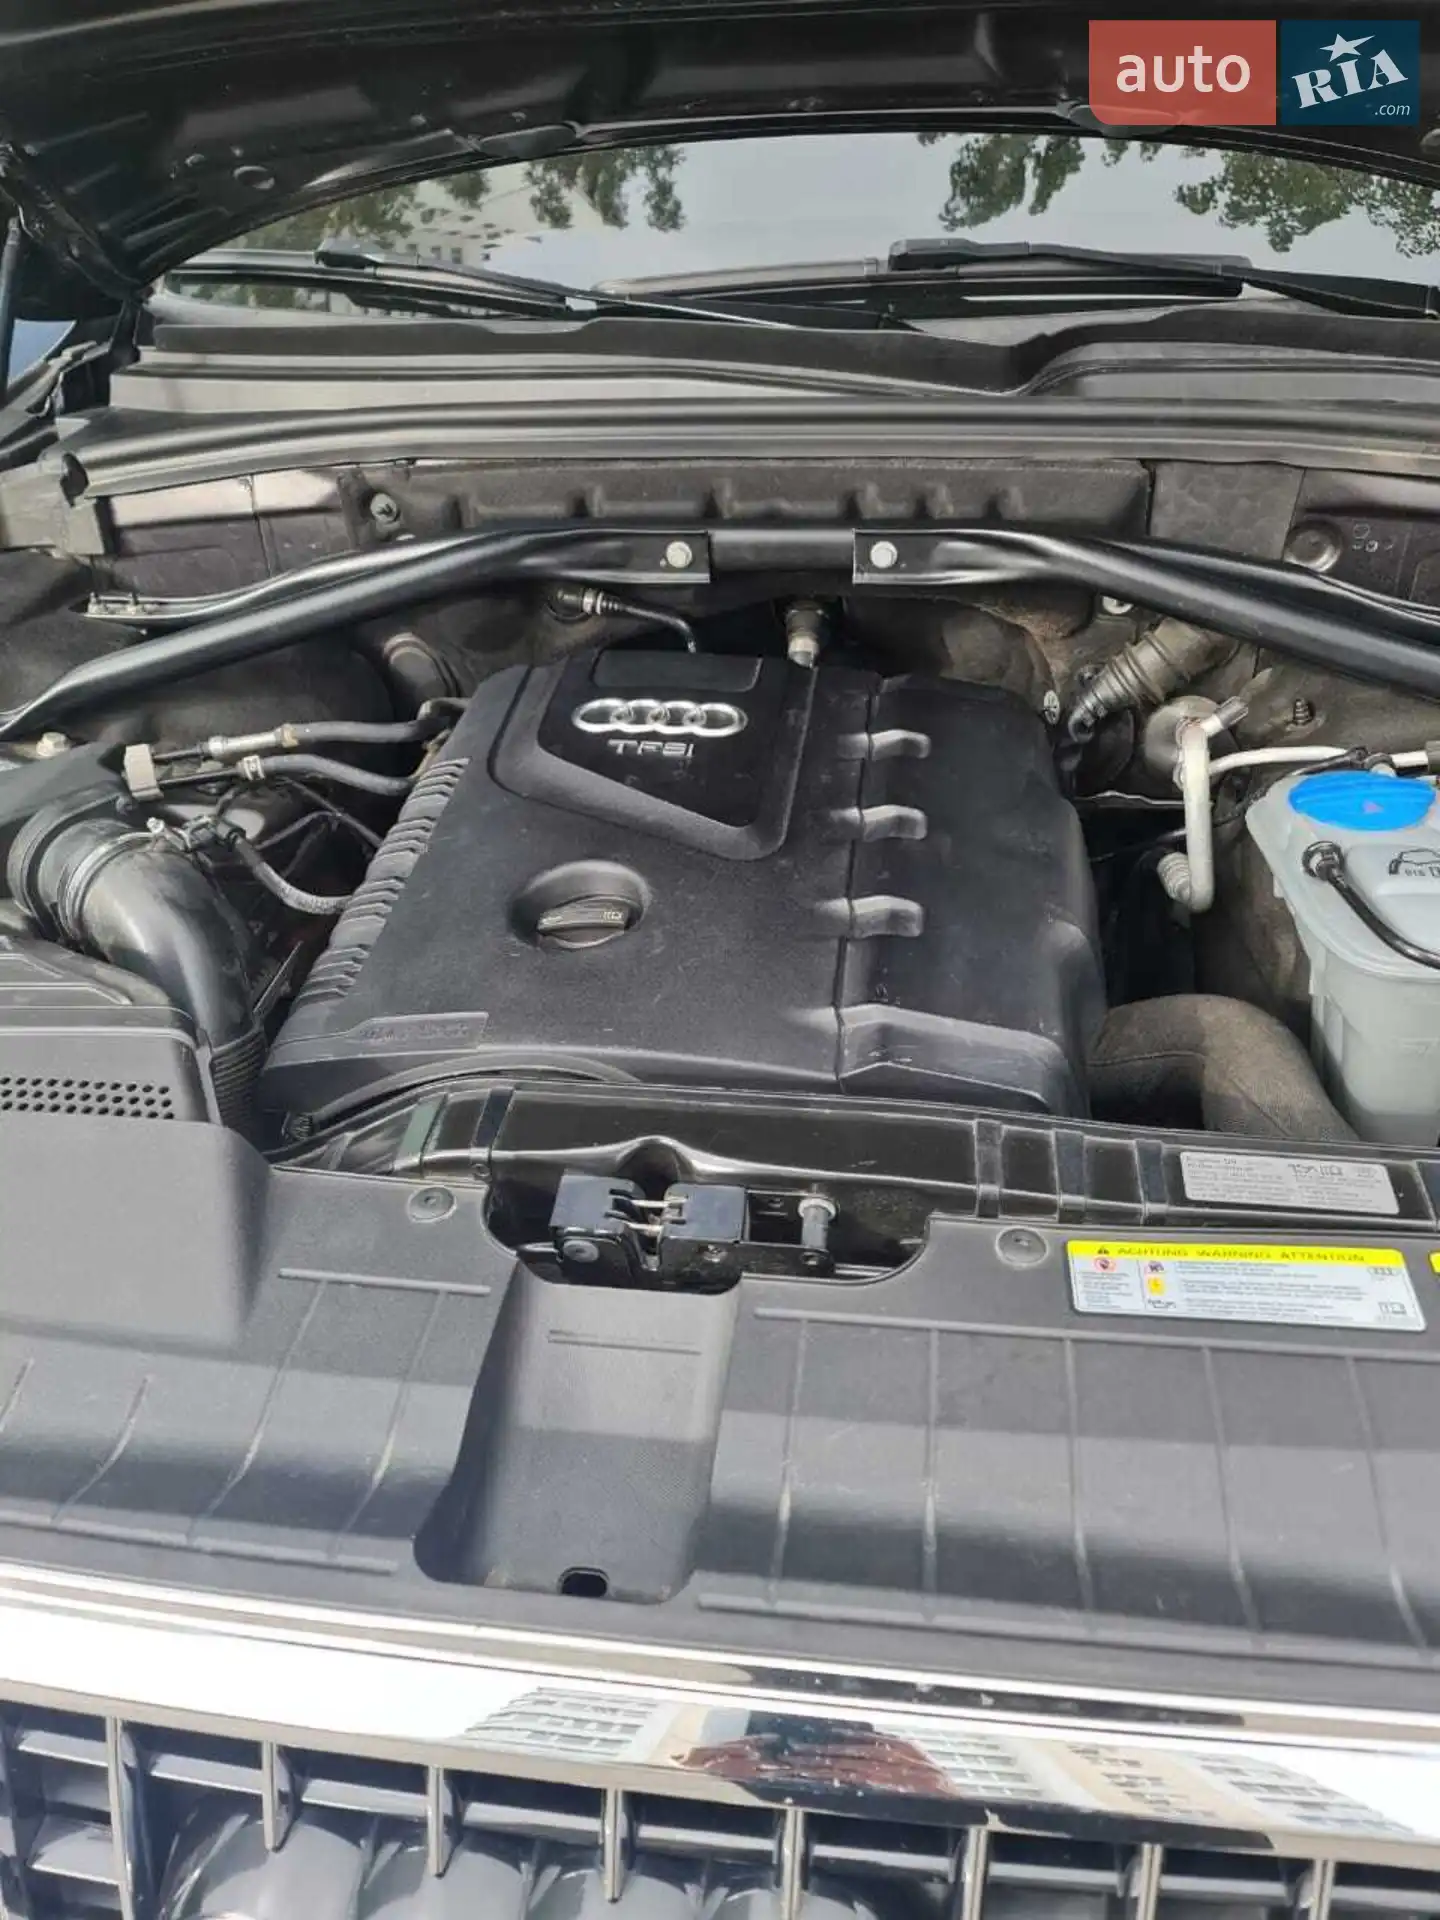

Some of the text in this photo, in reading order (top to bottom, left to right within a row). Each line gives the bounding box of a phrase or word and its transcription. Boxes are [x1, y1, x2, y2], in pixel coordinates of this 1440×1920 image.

[606, 738, 695, 758] TFSI
[1117, 1247, 1366, 1262] ACHTUNG WARNING ATTENTION
